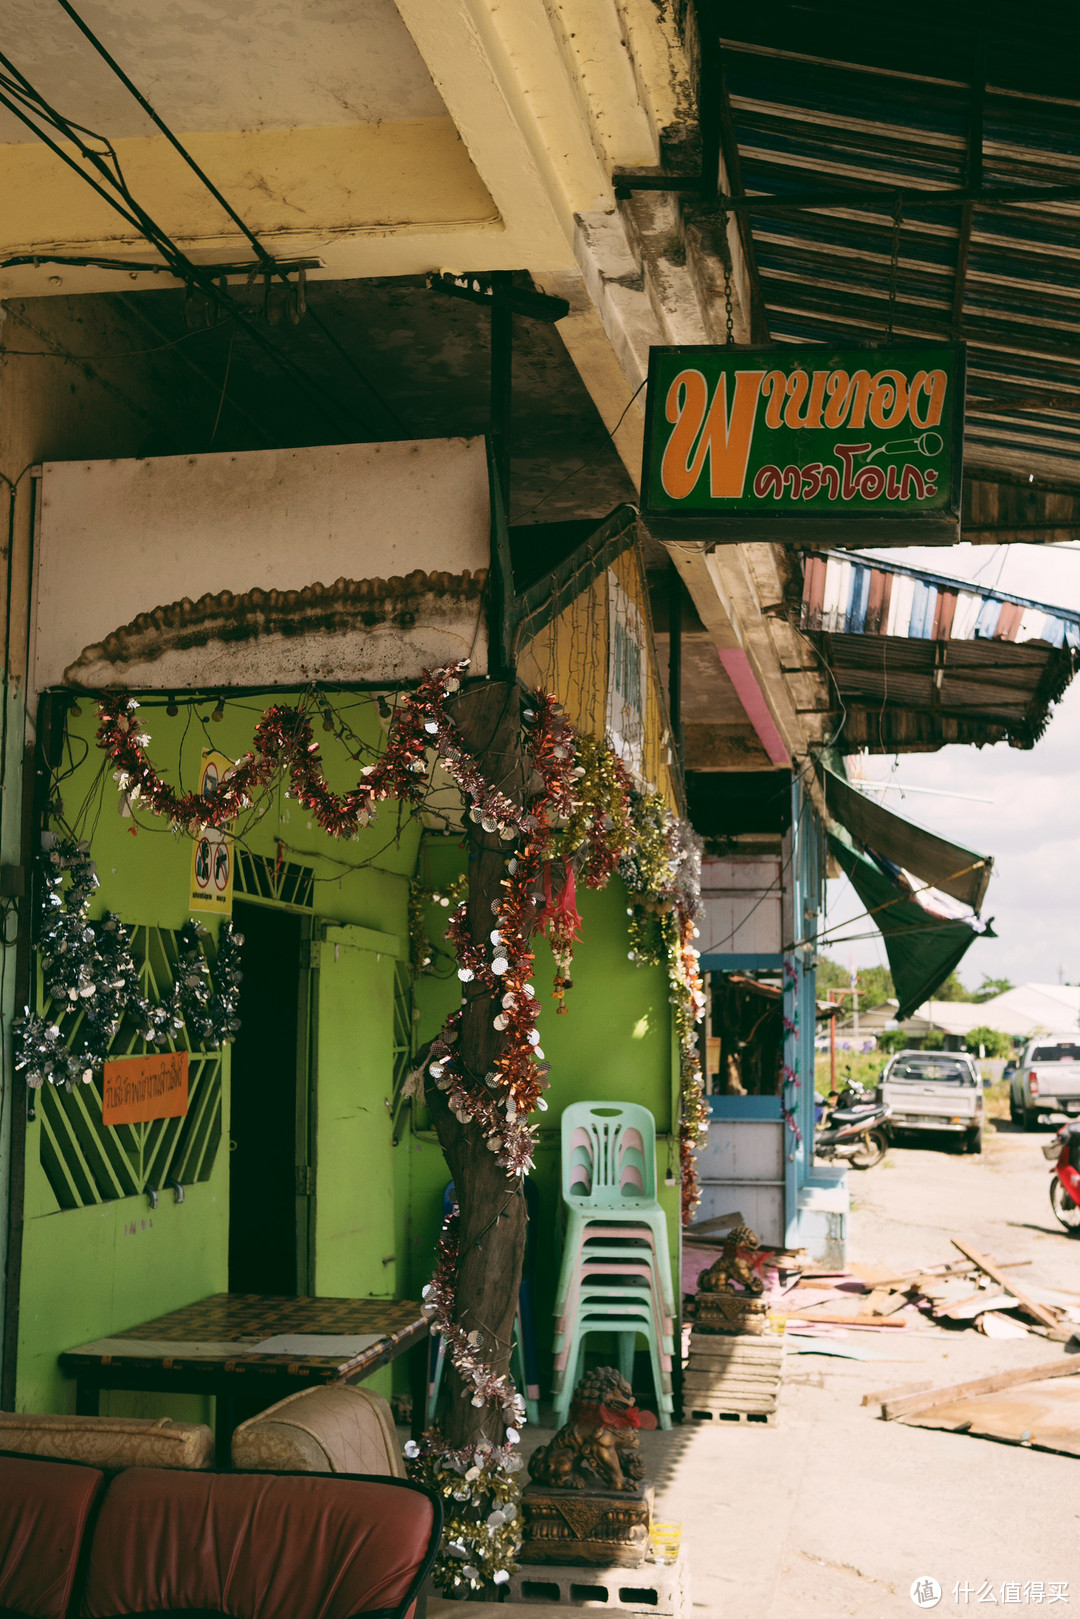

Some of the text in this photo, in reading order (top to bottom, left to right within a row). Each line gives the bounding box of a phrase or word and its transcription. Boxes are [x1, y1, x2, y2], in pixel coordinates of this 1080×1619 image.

[661, 368, 948, 500] พานทอง
[753, 442, 939, 501] คาราโอเกะ
